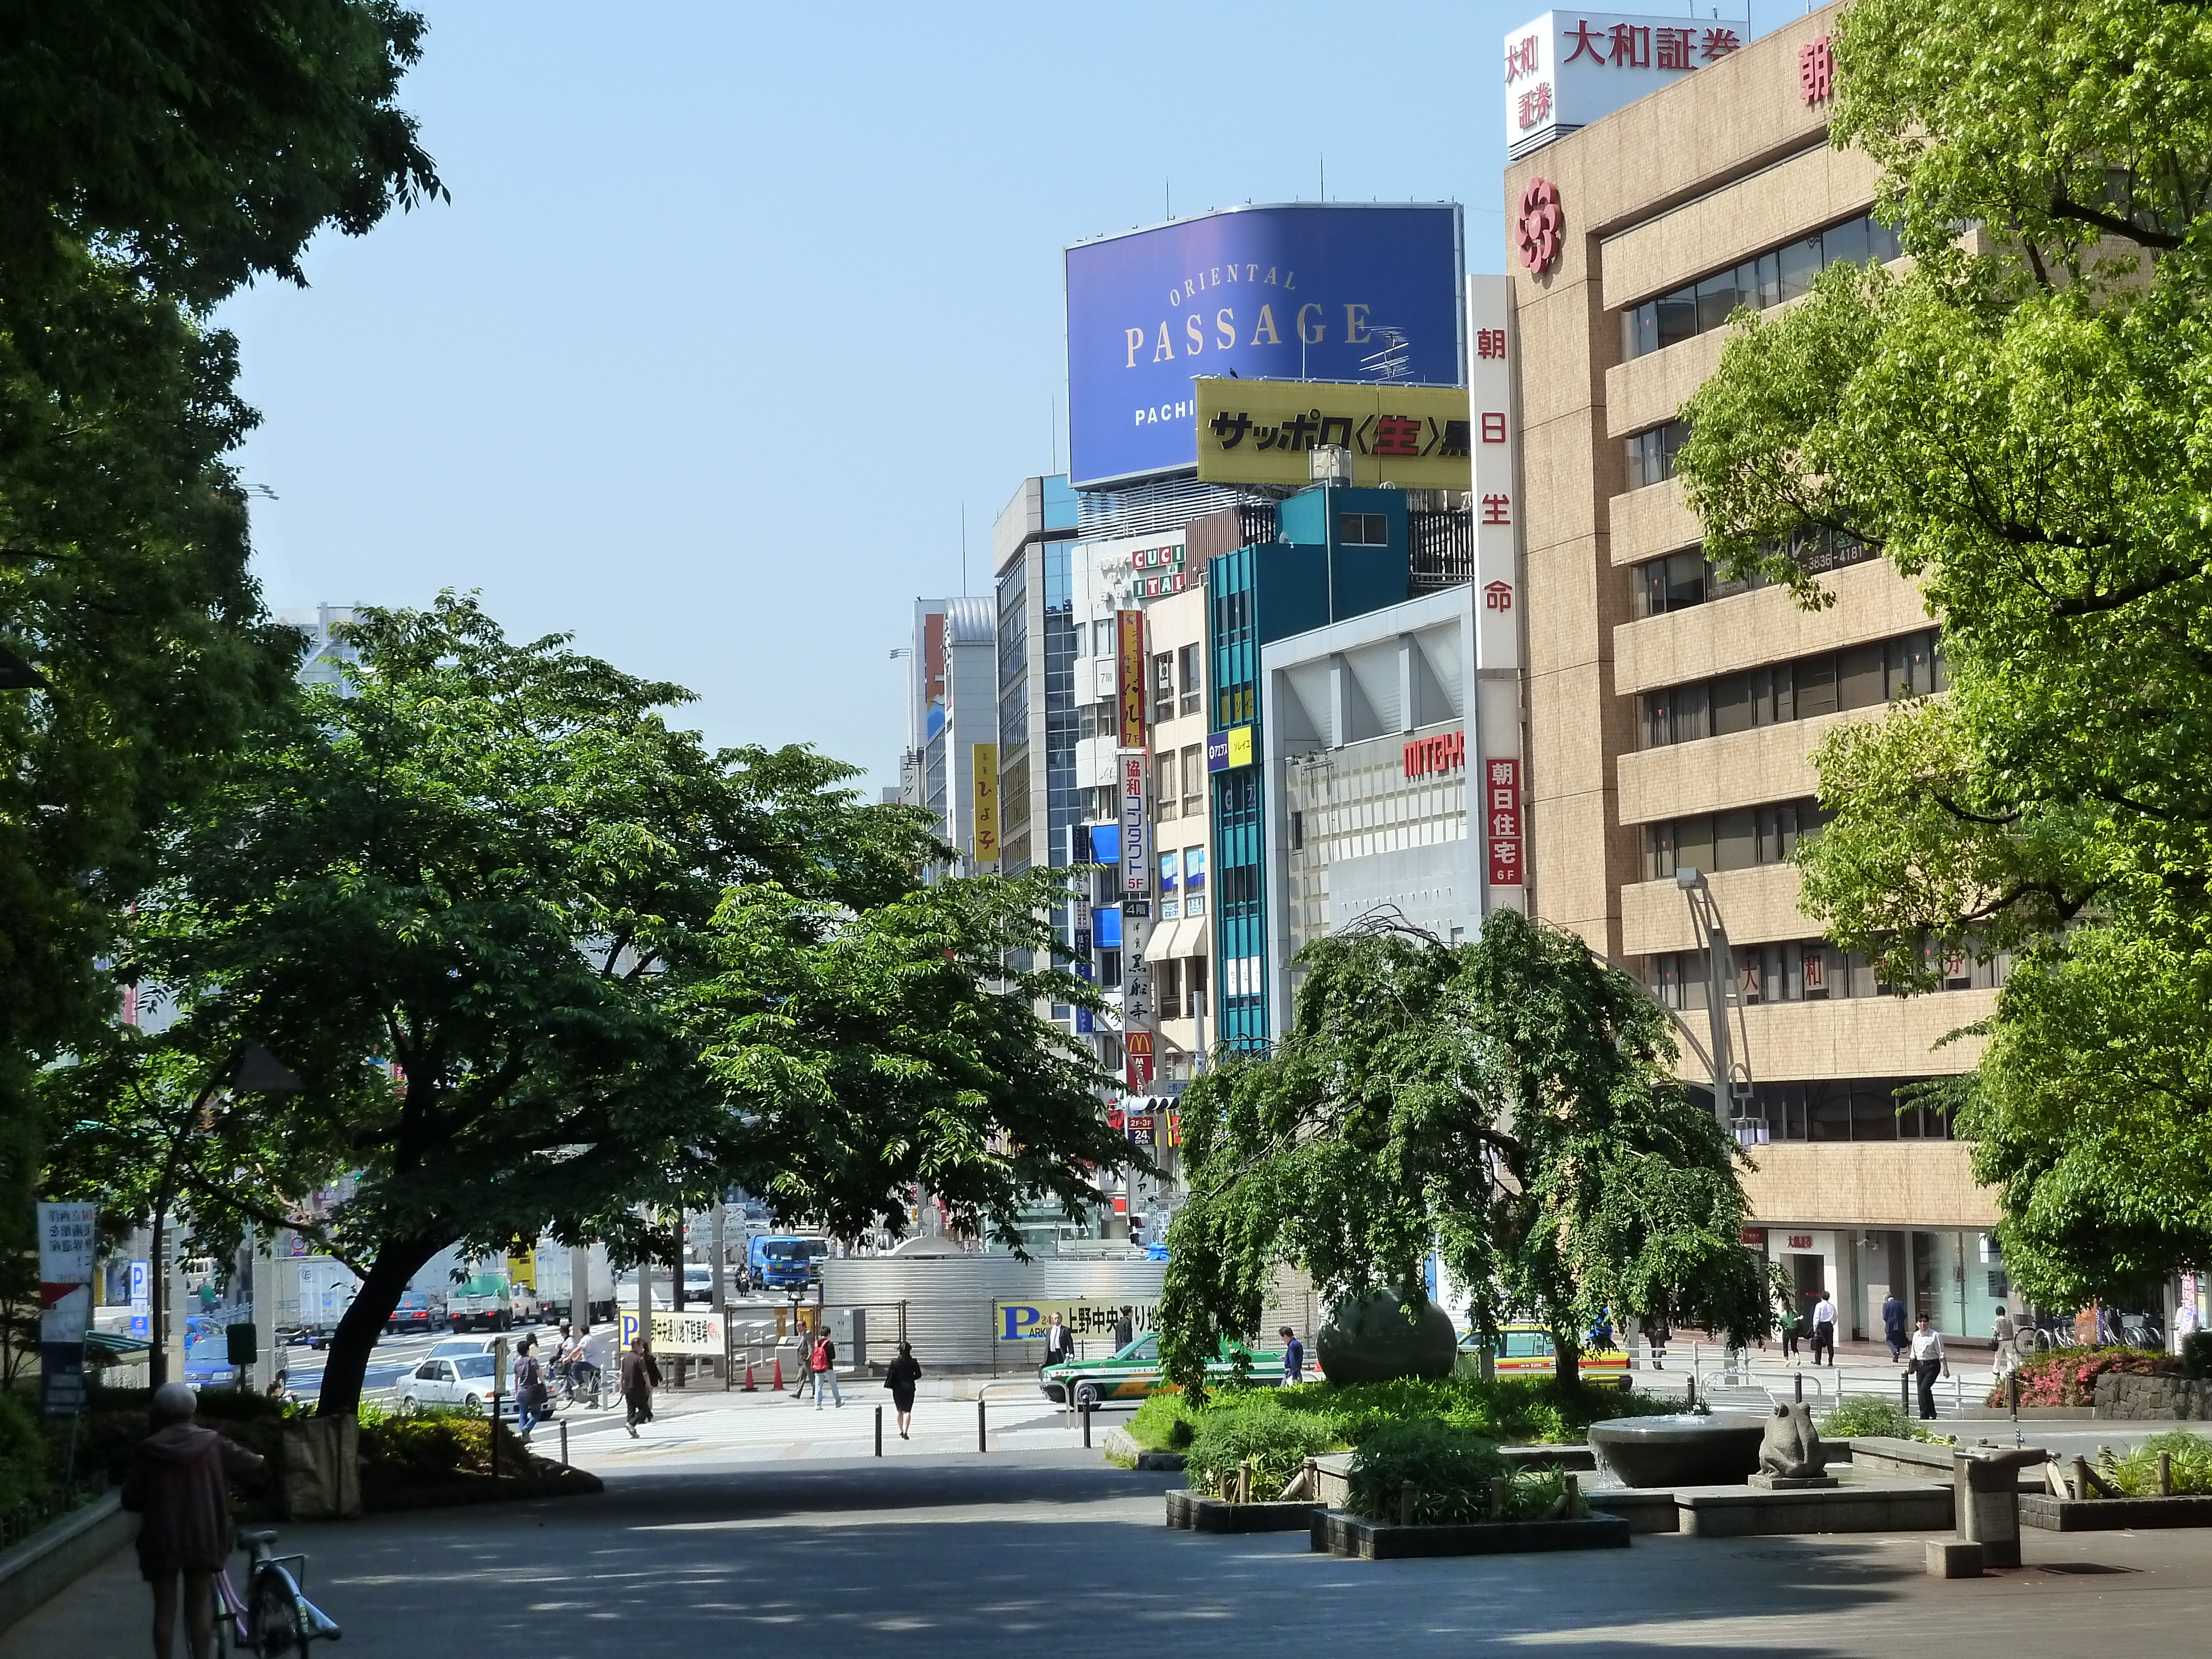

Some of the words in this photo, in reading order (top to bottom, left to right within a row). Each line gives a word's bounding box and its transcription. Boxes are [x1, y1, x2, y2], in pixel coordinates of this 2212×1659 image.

[1505, 35, 1538, 82] 大和
[1563, 20, 1740, 70] 大和証券
[1518, 82, 1551, 129] 証券
[1170, 263, 1297, 306] ORIENTAL
[1125, 303, 1371, 368] PASSAGE
[1135, 400, 1194, 426] PACHI
[1477, 327, 1513, 612] 朝日生命
[1135, 546, 1182, 567] CUCI
[1138, 576, 1183, 596] ITAL
[1100, 672, 1113, 684] 7階
[1121, 679, 1143, 723] バル
[1125, 733, 1140, 743] 7F
[1234, 740, 1251, 752] ソレイユ
[978, 781, 995, 850] ひよ子
[1125, 760, 1142, 875] 協和コンタクト
[1491, 763, 1516, 864] 朝日住宅
[1128, 878, 1144, 889] 5F
[1497, 869, 1514, 880] 6F
[1126, 904, 1146, 915] 4階
[1129, 954, 1149, 1020] 黒船亭
[133, 1266, 143, 1293] P
[622, 1316, 639, 1345] P
[1000, 1306, 1040, 1339] P
